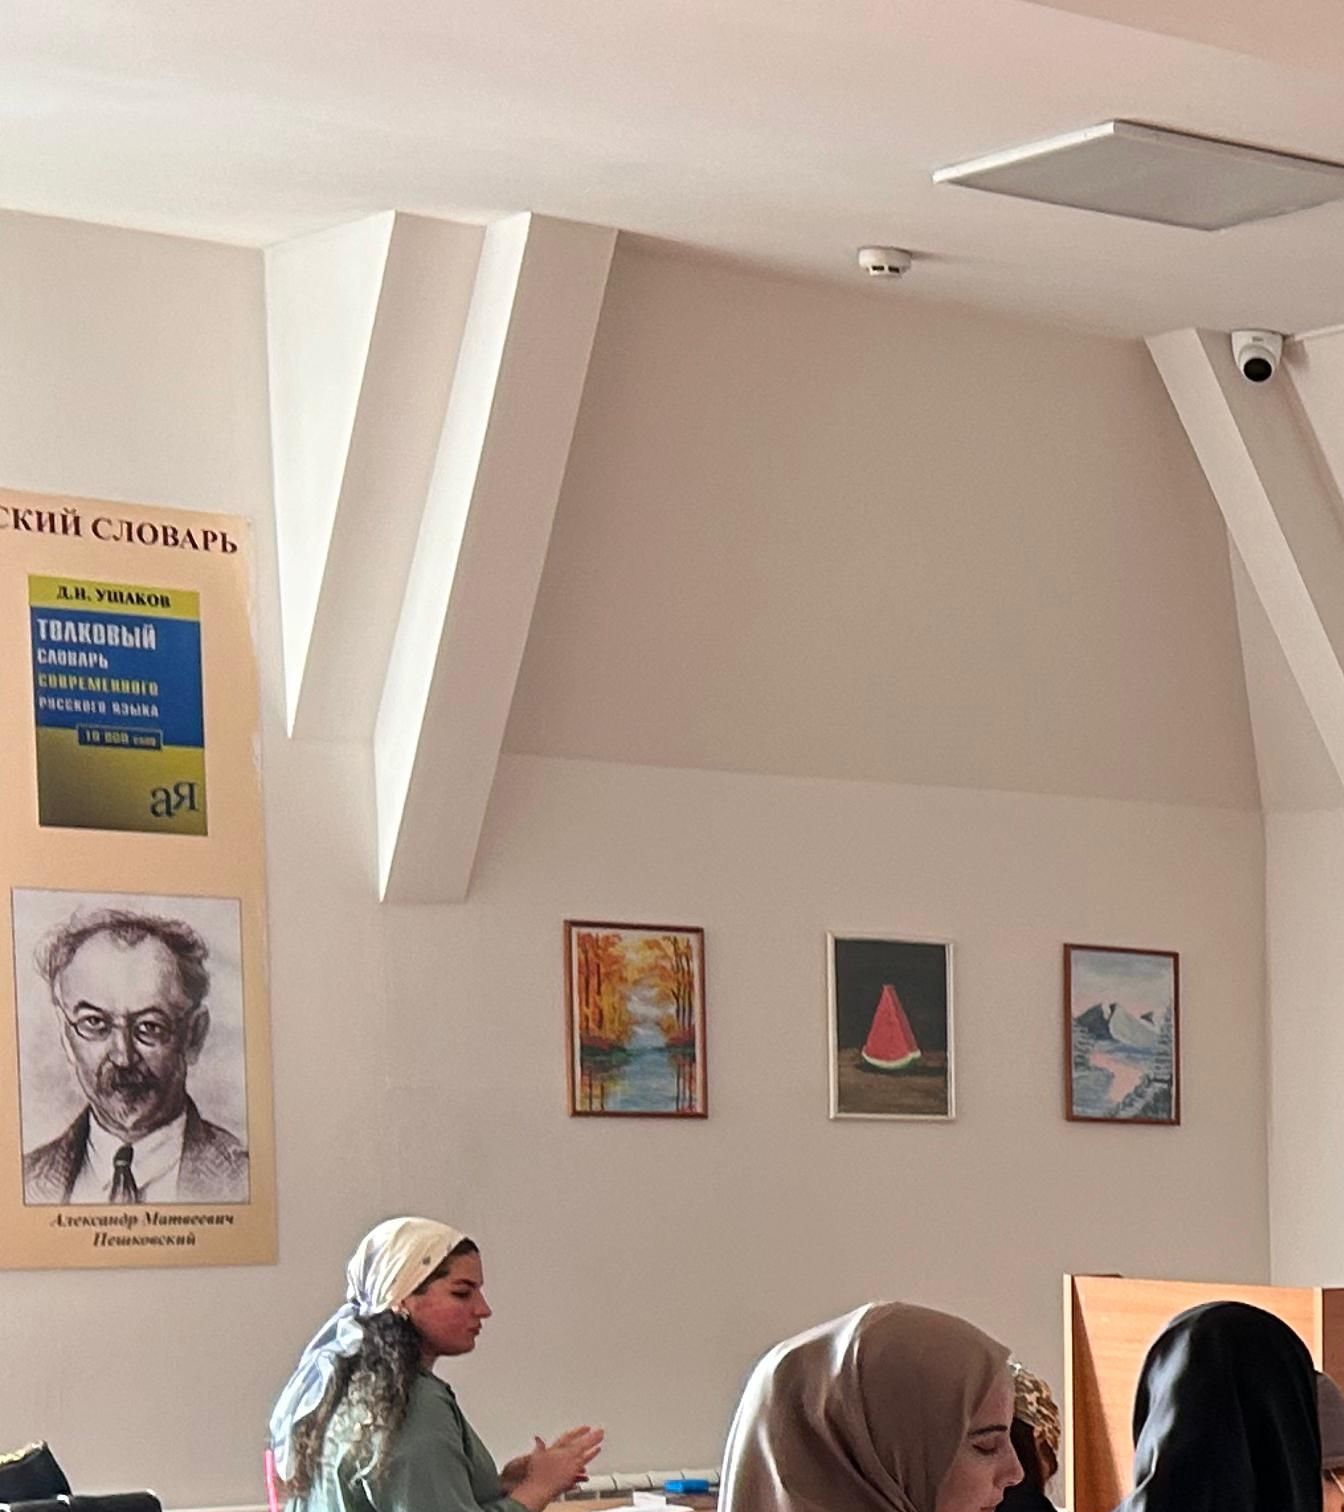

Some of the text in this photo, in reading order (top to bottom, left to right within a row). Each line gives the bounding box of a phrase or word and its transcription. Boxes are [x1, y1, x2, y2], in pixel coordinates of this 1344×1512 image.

[91, 517, 238, 554] СЛОВАРЬ
[96, 588, 172, 609] УШАКОВ
[36, 618, 157, 650] ТОЛКОВЫЙ
[37, 648, 109, 670] СЛОВАРЬ
[38, 672, 159, 697] СОВРЕМЕННОГО
[112, 701, 159, 718] ЯЗЫКА
[52, 1210, 235, 1229] Александр Матвеевич
[92, 1231, 197, 1248] Пешковский
